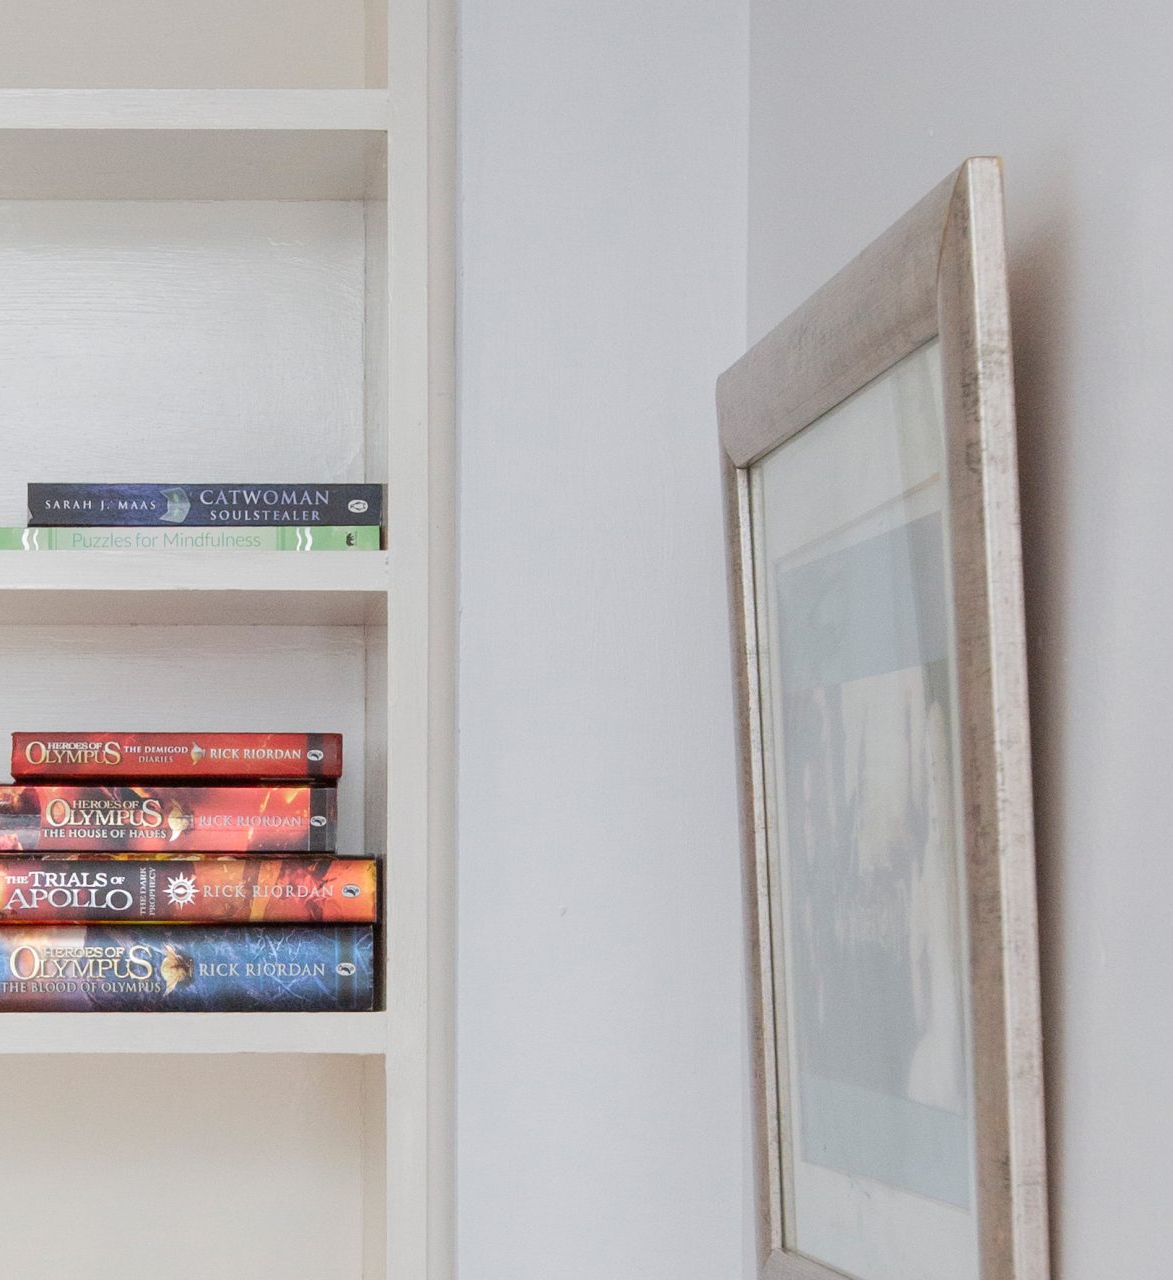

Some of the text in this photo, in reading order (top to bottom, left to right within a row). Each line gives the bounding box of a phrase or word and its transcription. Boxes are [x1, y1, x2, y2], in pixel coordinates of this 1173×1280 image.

[200, 489, 329, 506] CATWOMAN
[44, 499, 157, 511] SARAH J. MAAS
[210, 509, 321, 521] SOULSTEALER
[72, 532, 261, 549] Puzzles for Mindfulness
[47, 742, 103, 750] HEROES OF
[123, 745, 189, 754] THE DEMIGOD
[25, 741, 121, 765] OLYMPUS
[138, 755, 174, 763] DIARIES
[210, 748, 302, 759] RICK RIORDAN
[72, 800, 140, 809] HEROES OF
[45, 798, 163, 828] OLYMPUS
[198, 815, 304, 827] RICK RIORDAN
[42, 829, 167, 839] THE HOUSE OF HADES
[4, 871, 126, 888] THE TRIALS OF
[139, 866, 147, 916] THE DARK
[148, 866, 156, 916] PROPHECY
[203, 885, 335, 898] RICK RIORDAN
[3, 888, 134, 911] APOLLO
[43, 947, 125, 958] HEROES OF
[9, 944, 155, 982] OLYMPUS
[198, 963, 326, 976] RICK RIORDAN
[1, 981, 162, 993] THE BLOOD OF OLYMPUS
